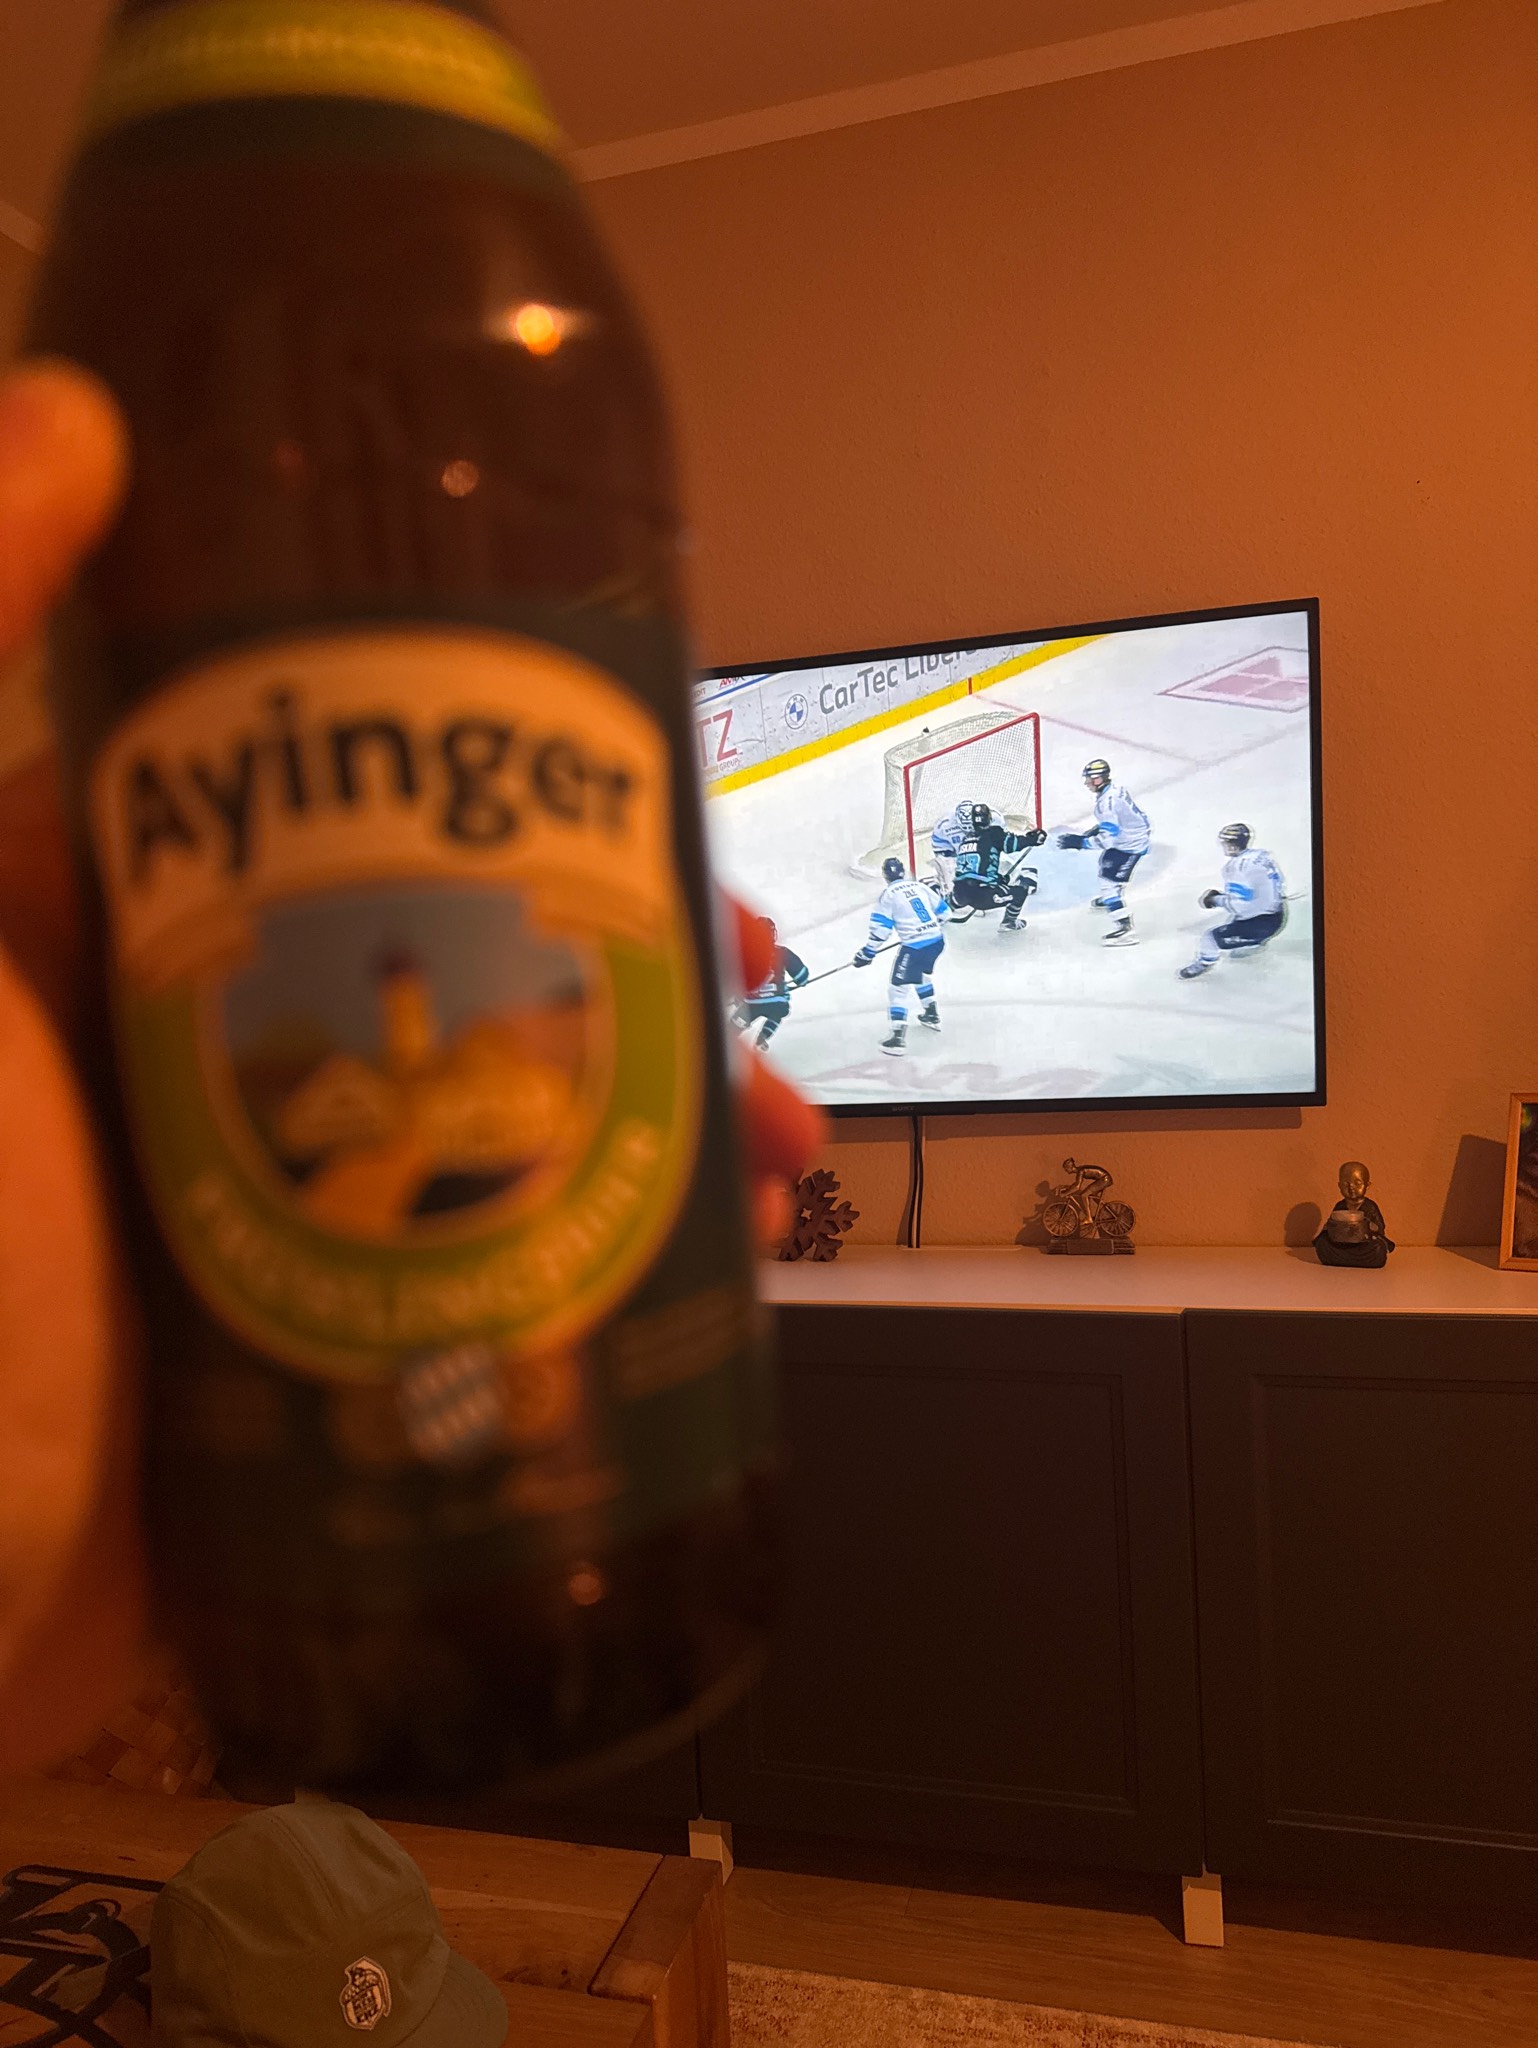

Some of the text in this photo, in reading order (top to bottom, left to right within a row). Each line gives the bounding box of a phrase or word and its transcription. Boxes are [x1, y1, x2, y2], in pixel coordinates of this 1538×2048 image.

[819, 650, 976, 715] CarTec Libe
[130, 683, 636, 886] Ayinger
